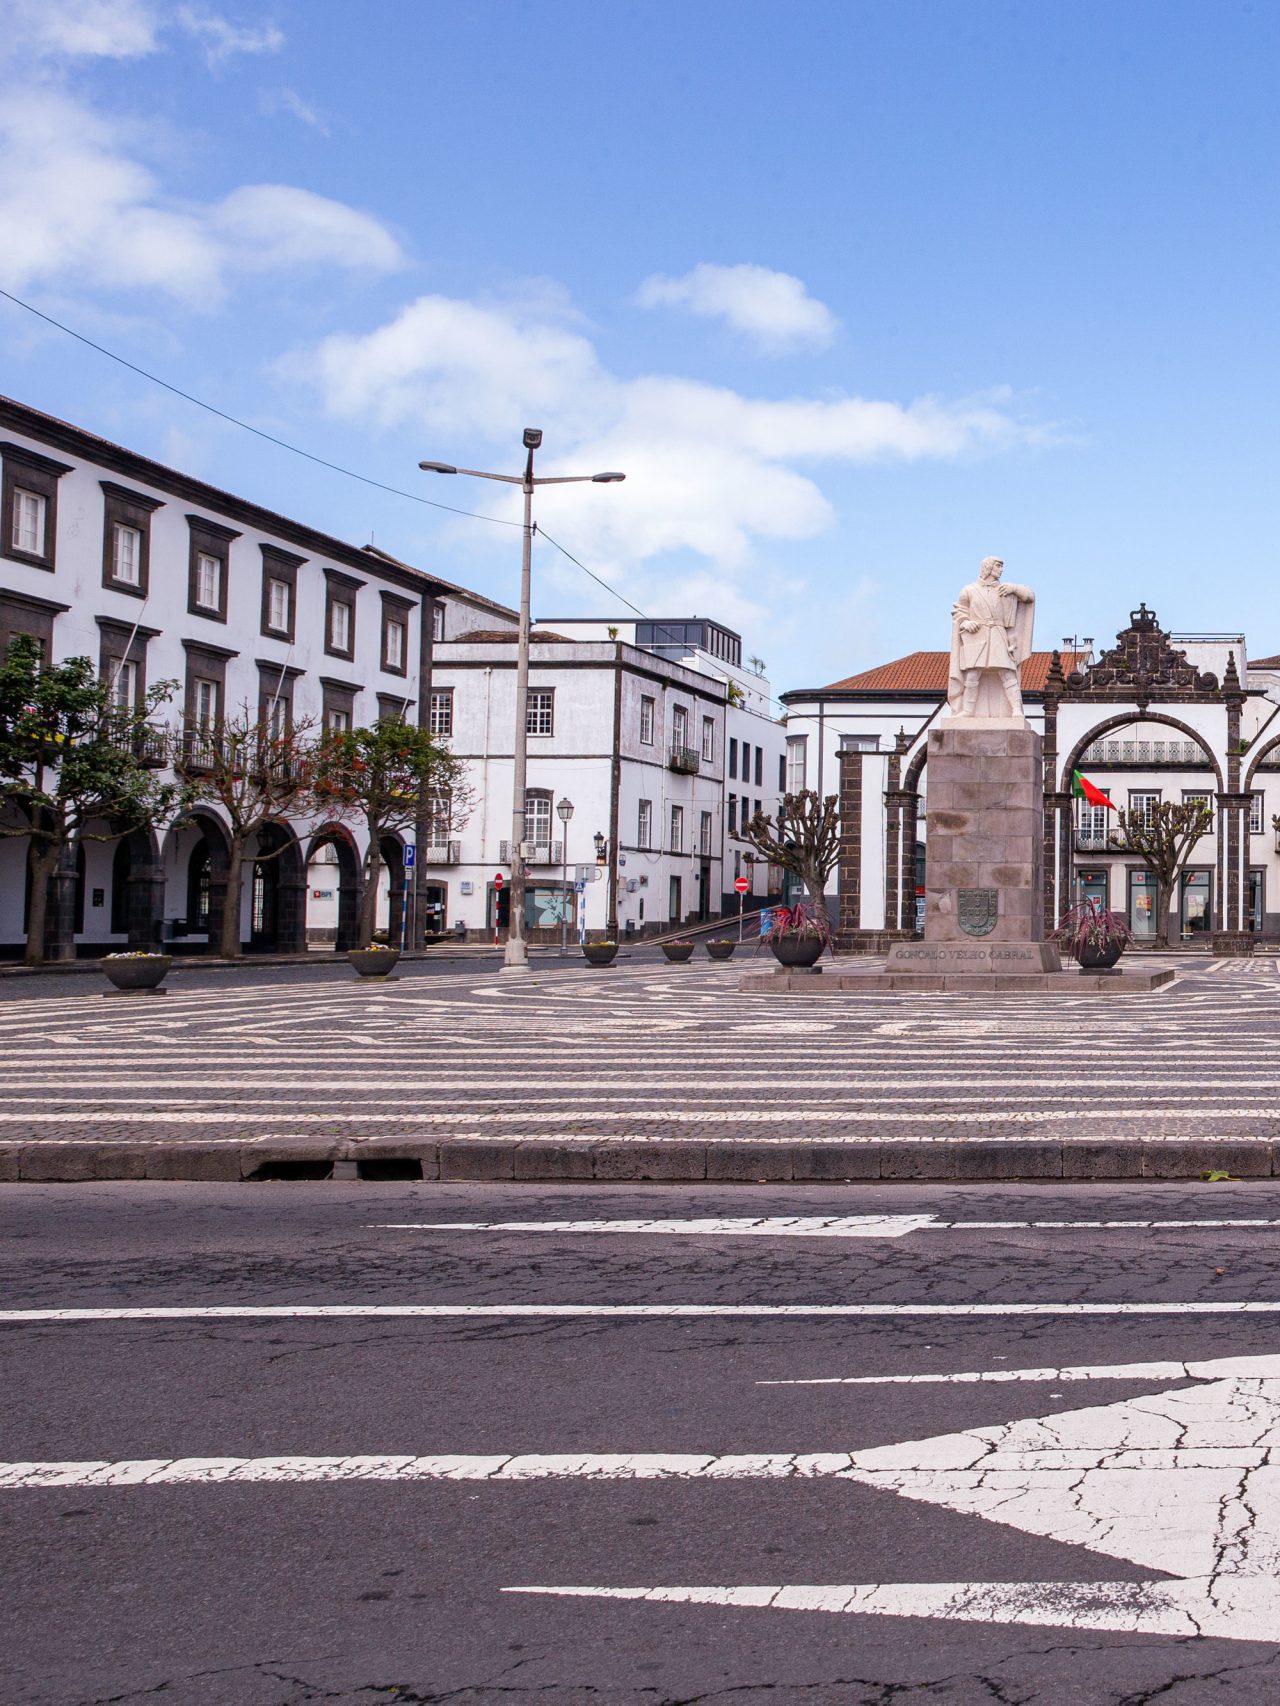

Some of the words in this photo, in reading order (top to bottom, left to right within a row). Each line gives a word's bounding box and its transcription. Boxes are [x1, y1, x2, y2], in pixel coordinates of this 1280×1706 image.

[406, 847, 413, 864] P
[895, 950, 946, 961] GONÇALO
[949, 950, 987, 960] VELHO
[989, 950, 1034, 960] CABRAL
